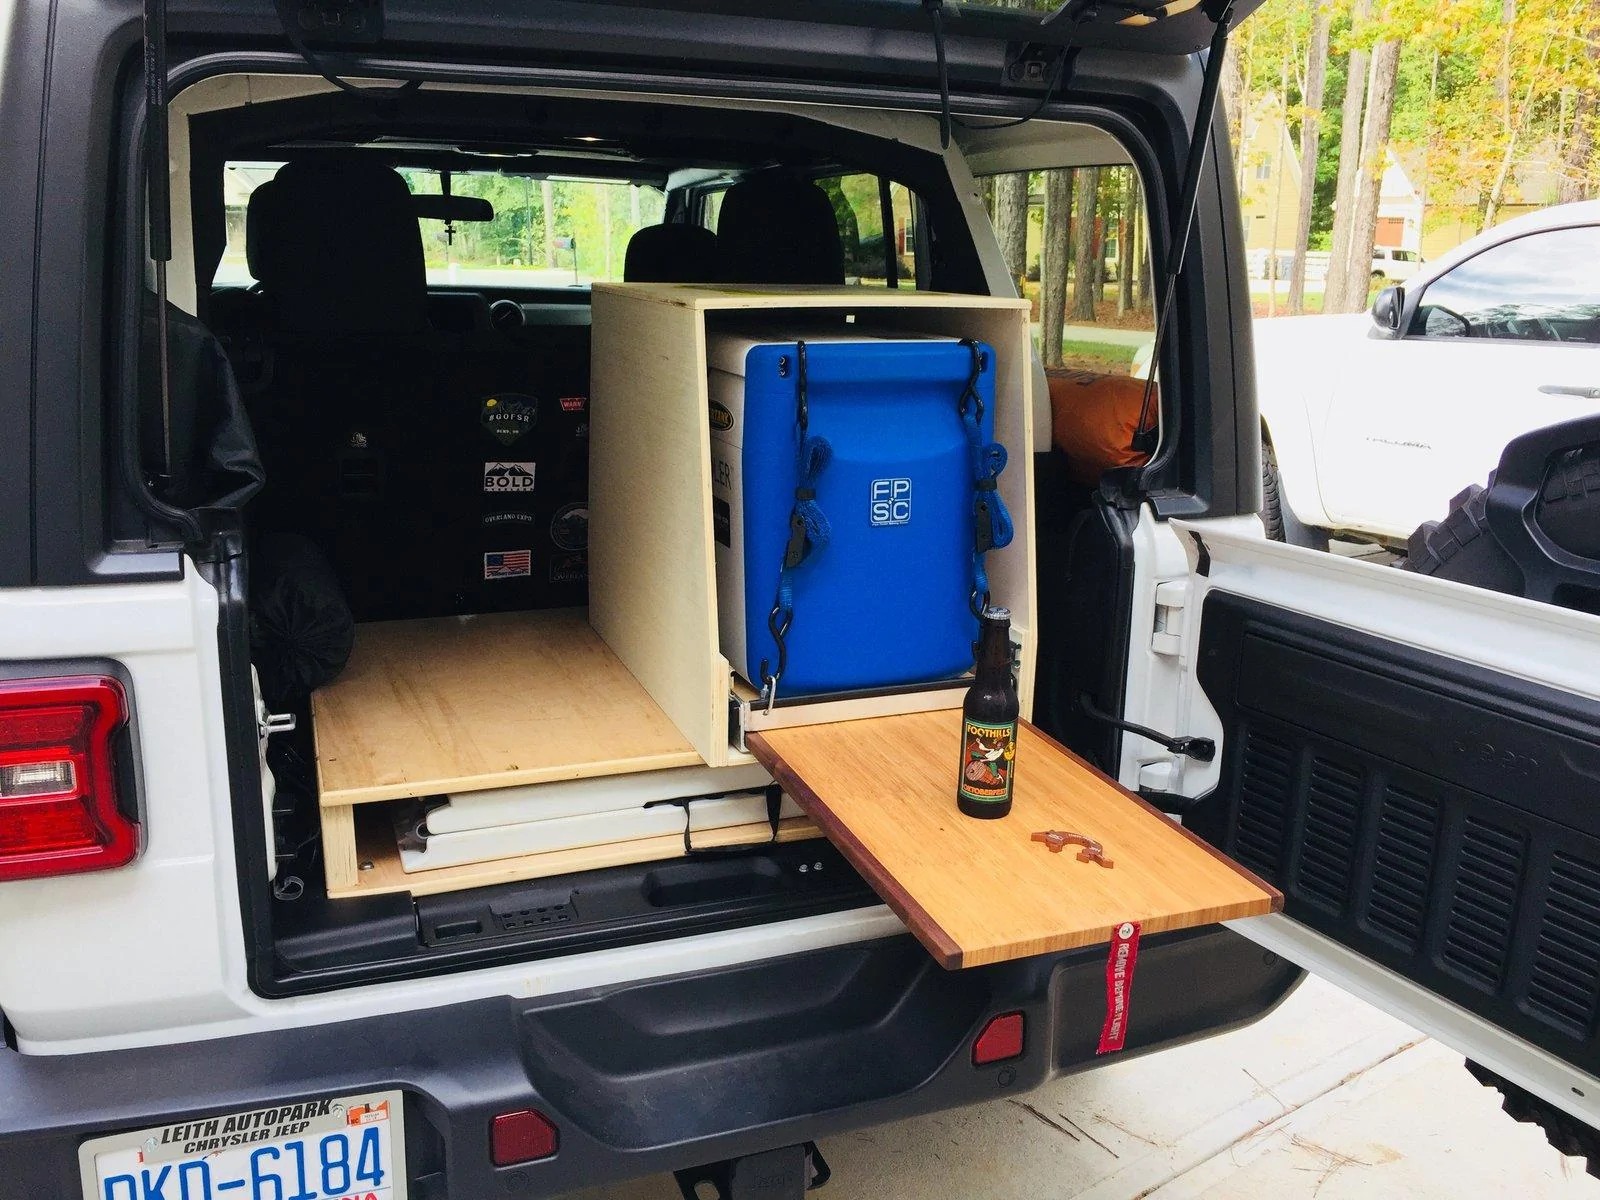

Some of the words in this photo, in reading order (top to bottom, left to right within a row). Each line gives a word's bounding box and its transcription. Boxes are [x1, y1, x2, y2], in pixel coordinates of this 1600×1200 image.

[489, 413, 530, 422] #GOFSR
[485, 477, 534, 488] BOLD
[967, 725, 1011, 738] FOOTHILLS
[1114, 943, 1130, 979] REMOVE
[161, 1117, 218, 1145] LEITH
[222, 1100, 333, 1135] AUTOPARK
[183, 1129, 270, 1154] CHRYSLER
[272, 1121, 311, 1137] JEEP
